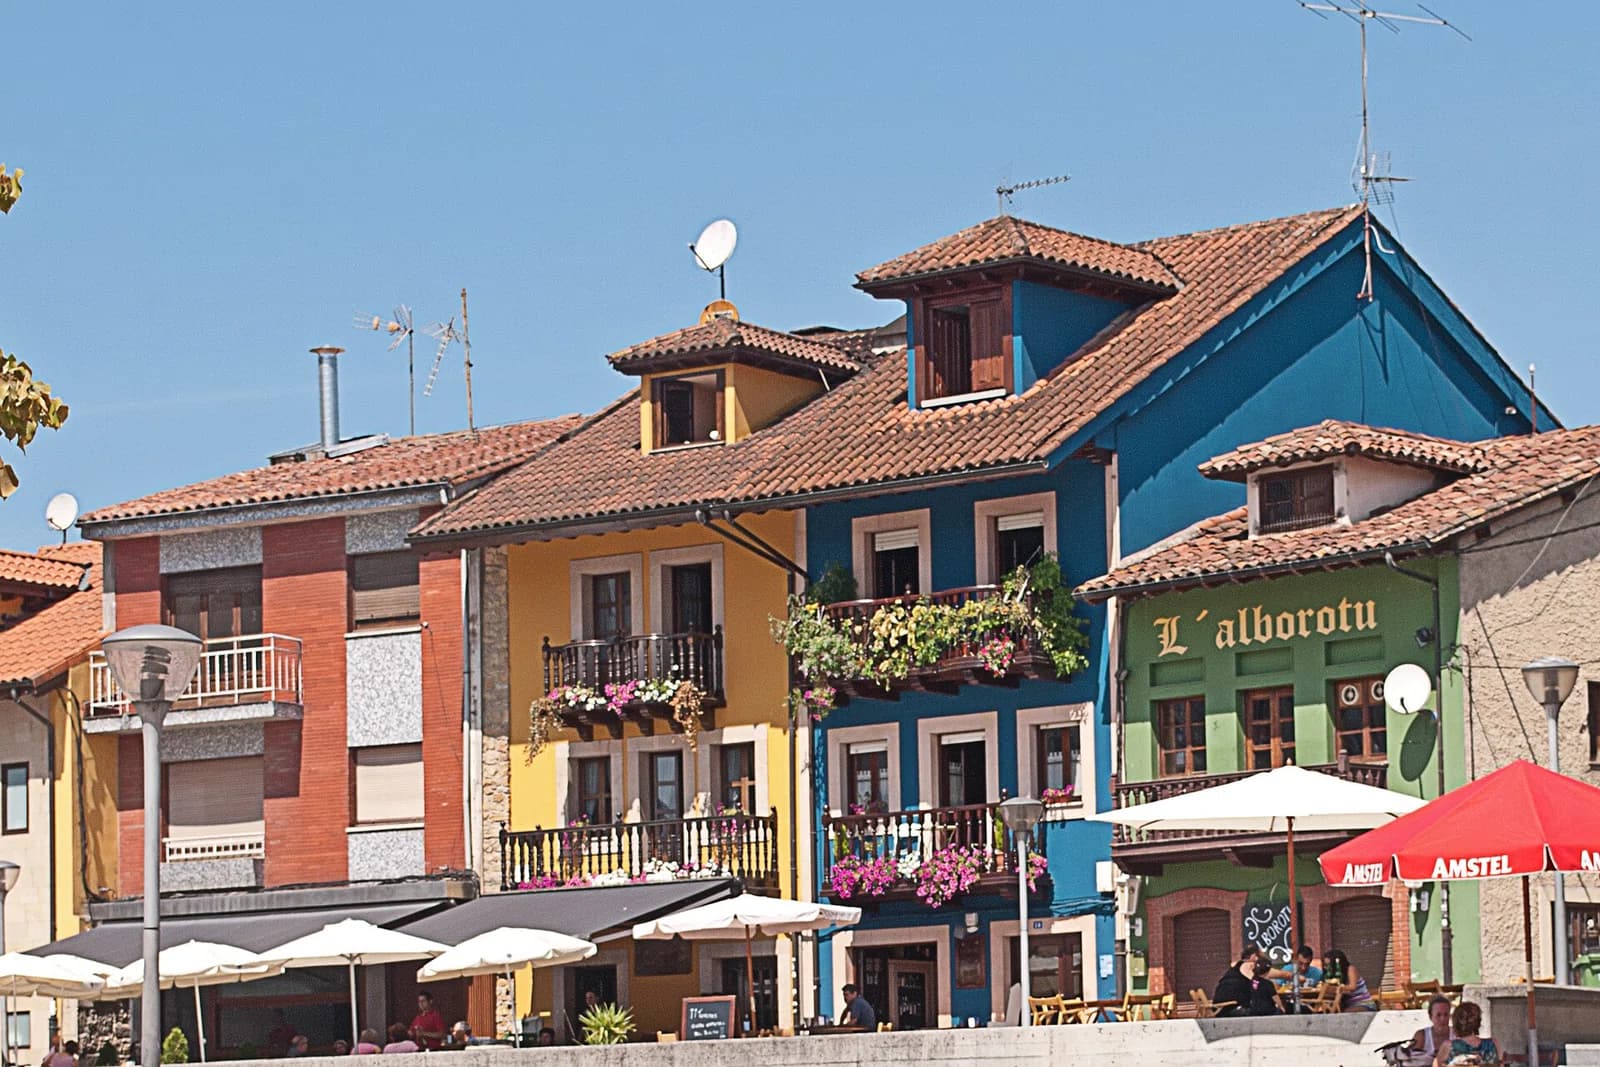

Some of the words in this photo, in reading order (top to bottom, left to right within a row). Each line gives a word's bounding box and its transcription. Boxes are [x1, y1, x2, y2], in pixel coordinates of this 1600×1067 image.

[1341, 863, 1383, 883] AMSTEL
[1431, 854, 1512, 879] AMSTEL
[1255, 905, 1292, 952] LBOROT
